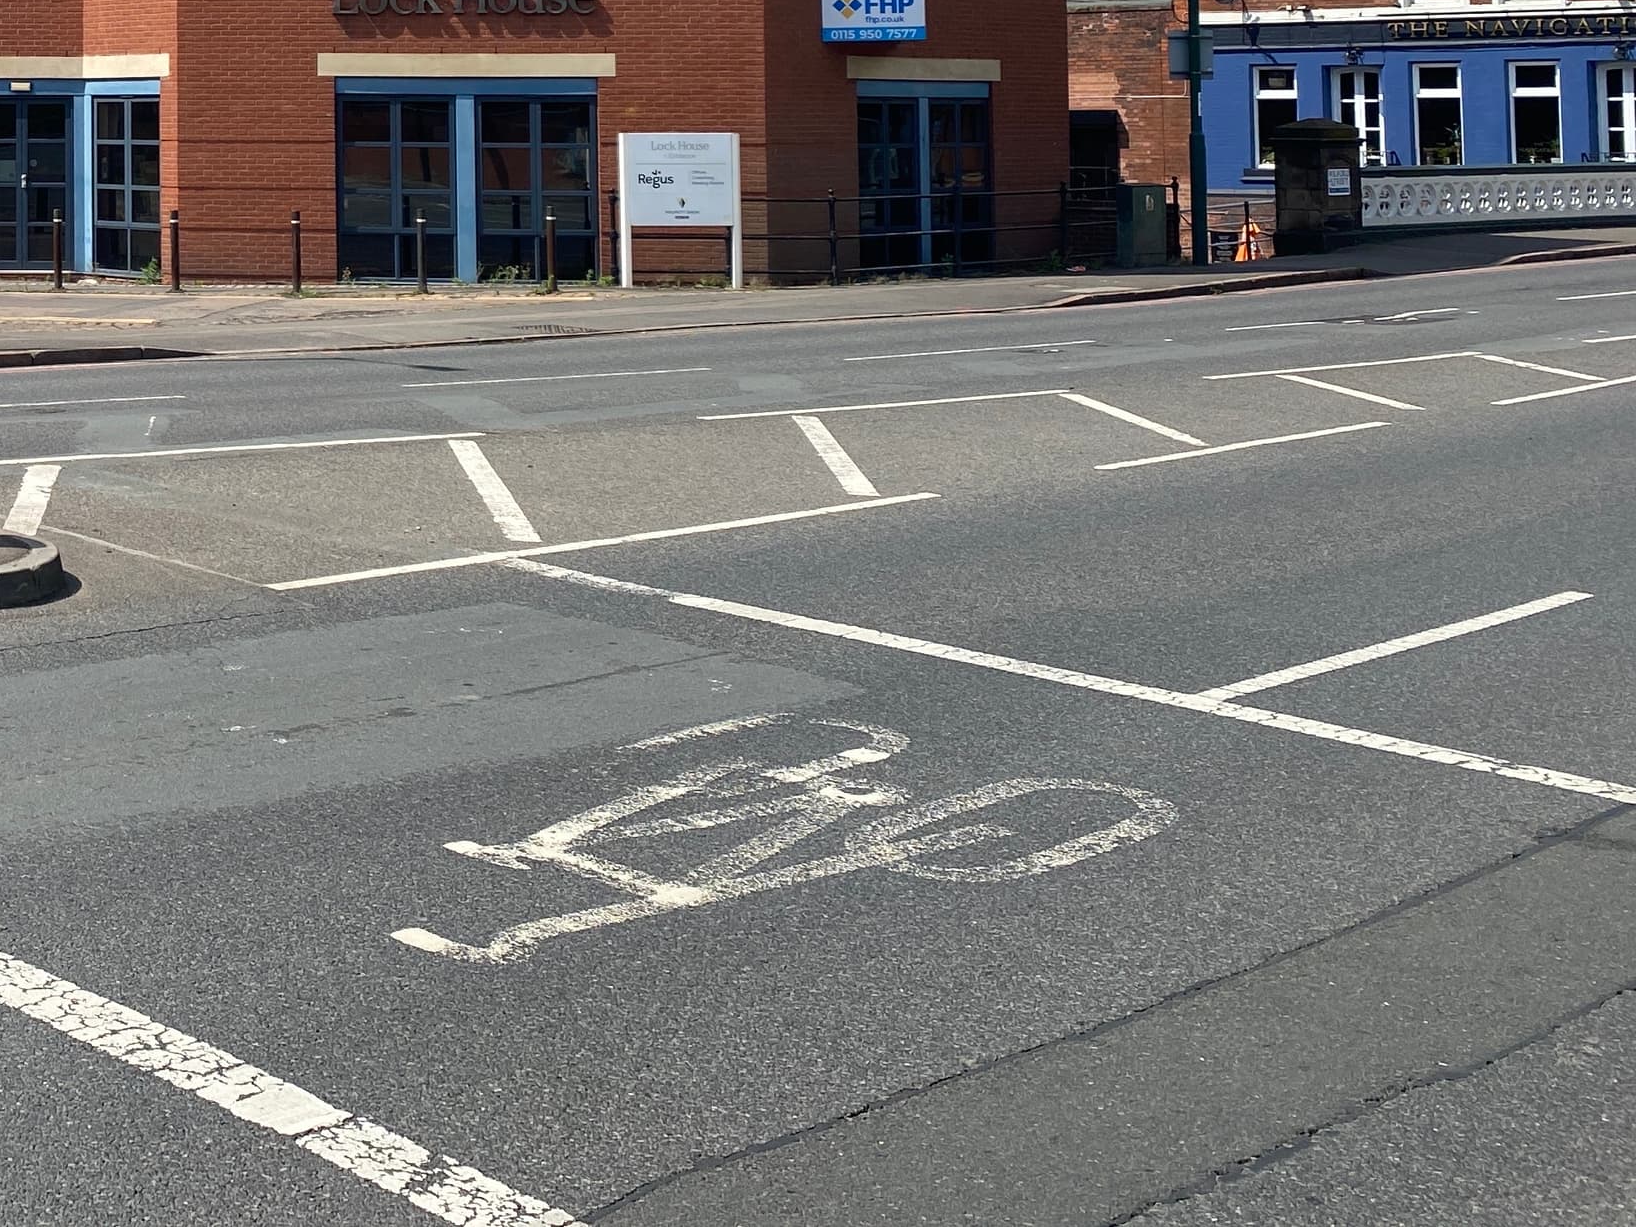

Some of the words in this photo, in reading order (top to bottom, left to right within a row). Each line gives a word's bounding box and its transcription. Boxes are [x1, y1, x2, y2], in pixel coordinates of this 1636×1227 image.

[865, 15, 905, 24] fhp.co.uk
[1387, 21, 1450, 39] THE
[1465, 16, 1630, 38] NAVIGATI
[830, 29, 855, 40] 0115
[859, 29, 883, 39] 950
[886, 28, 917, 39] 7577
[650, 140, 676, 151] Lock
[677, 140, 710, 151] House
[637, 173, 674, 189] Regus
